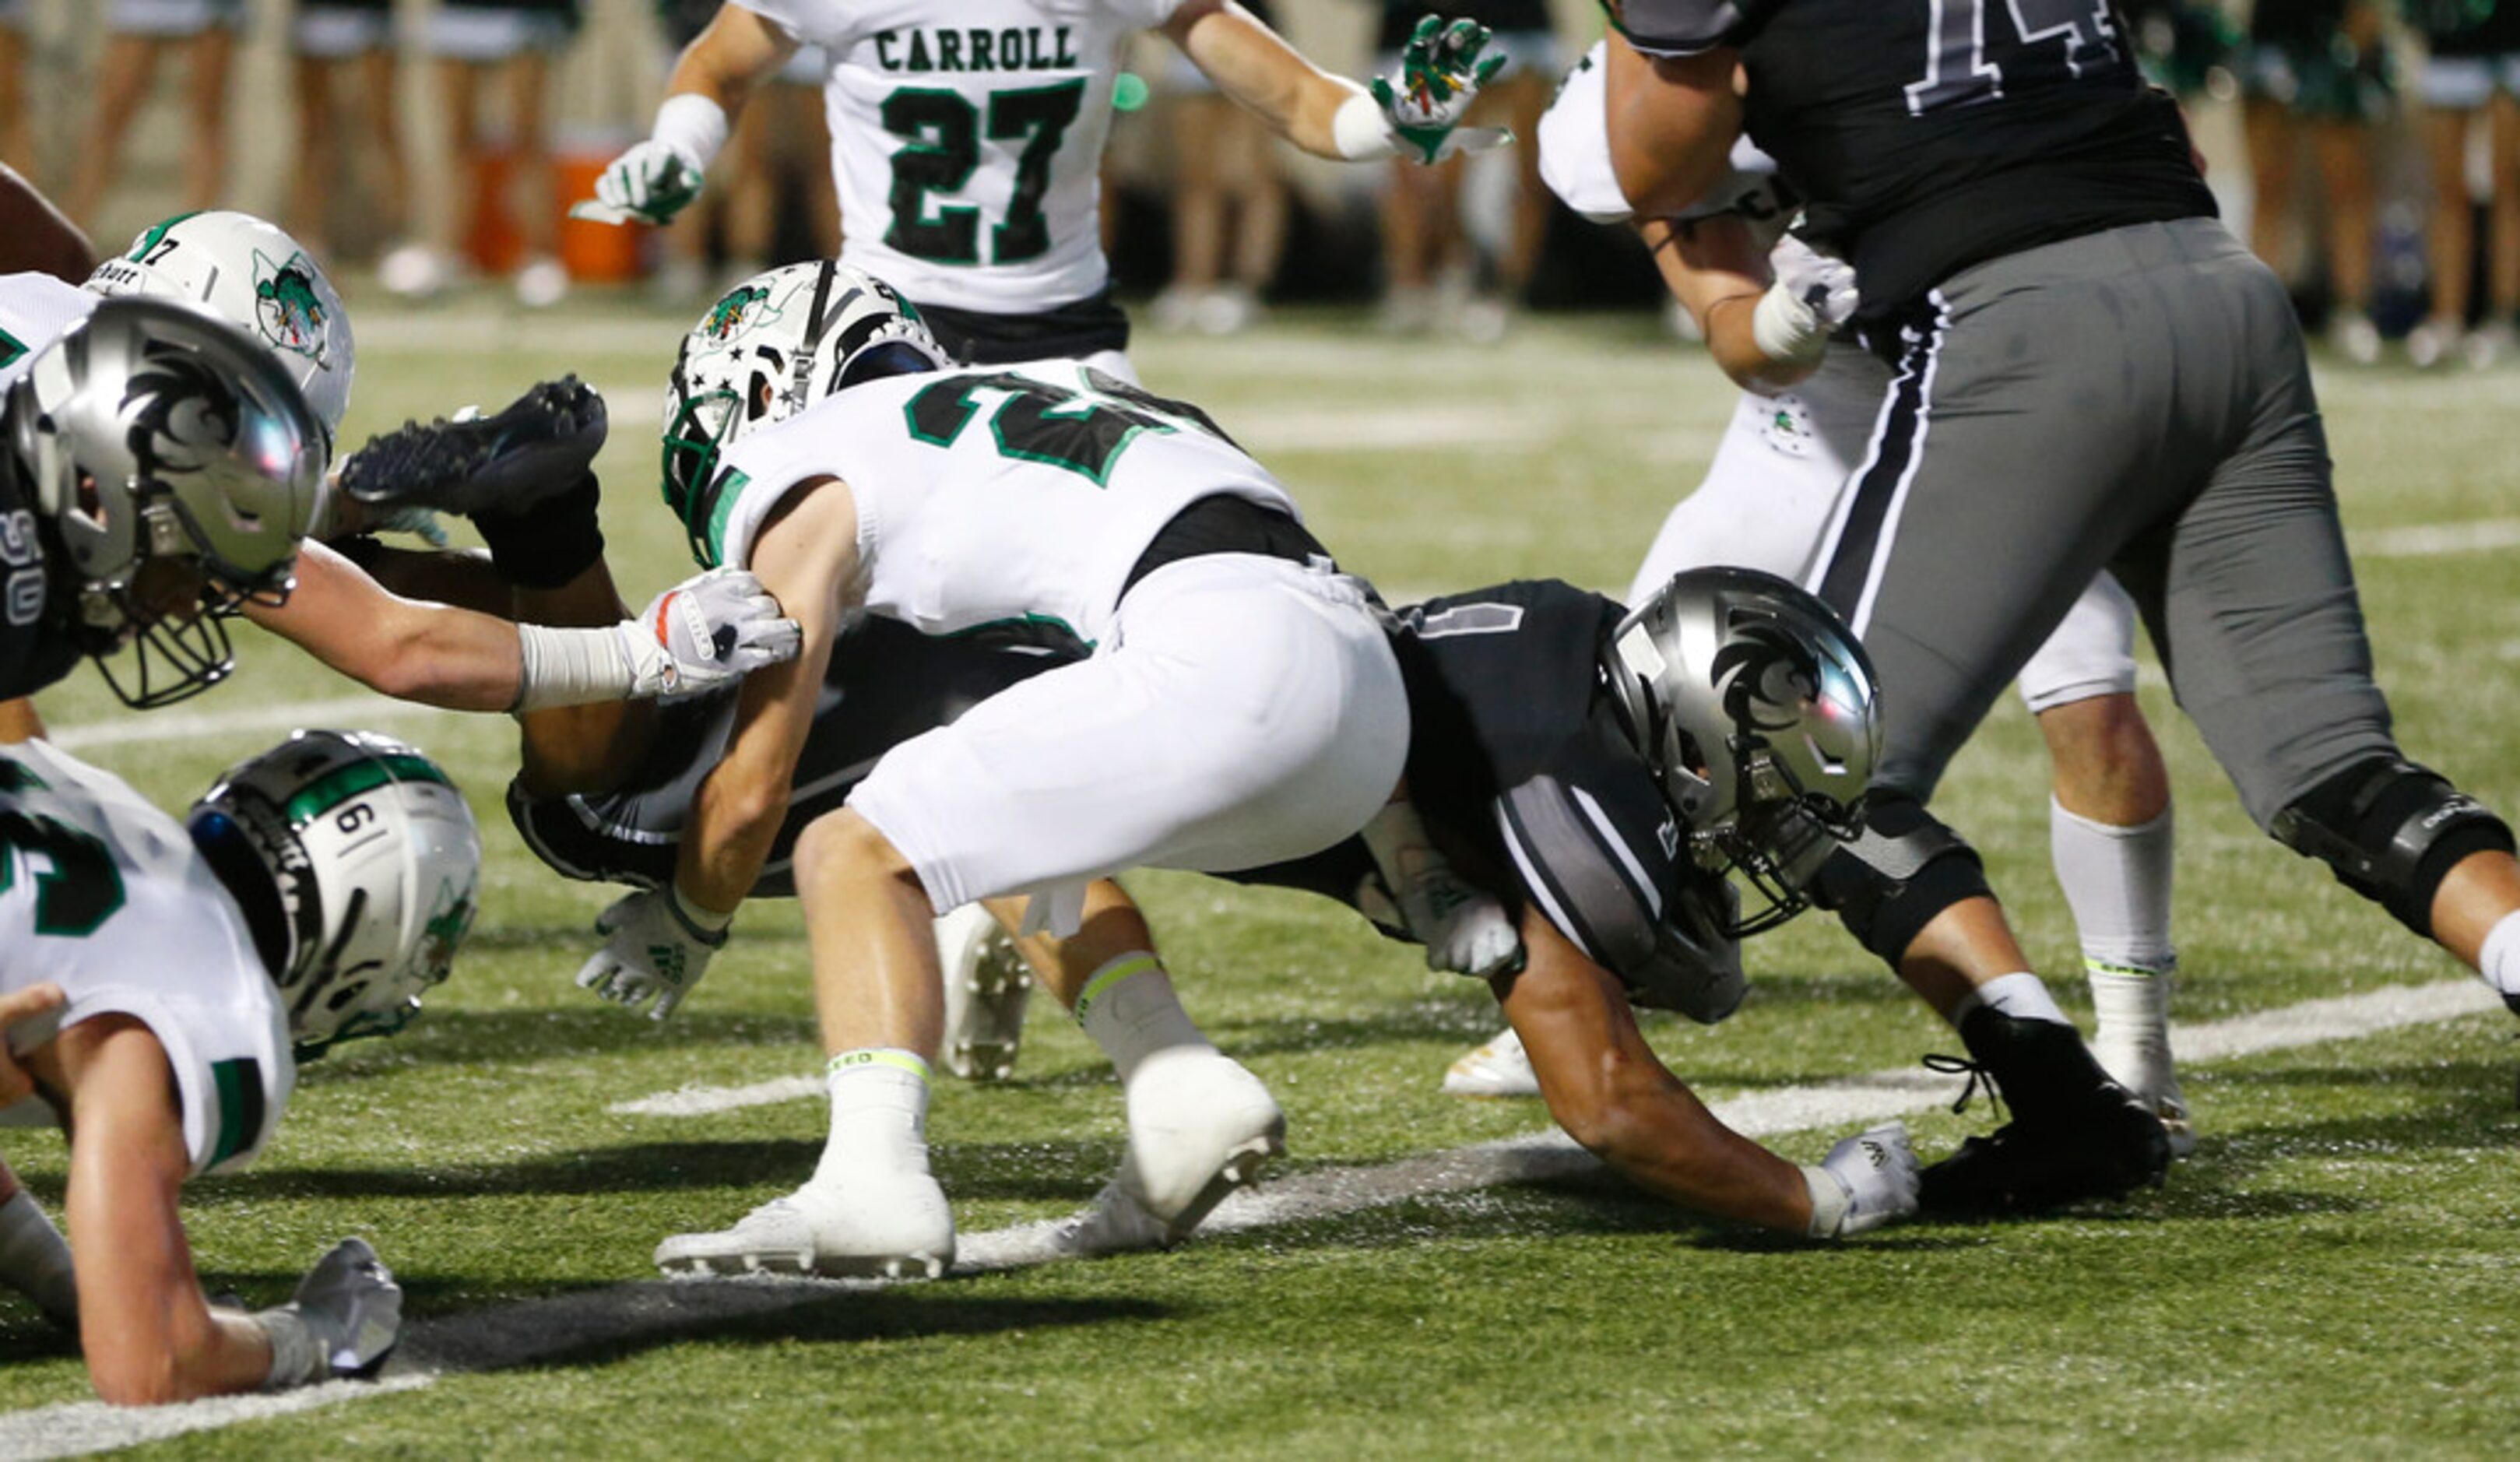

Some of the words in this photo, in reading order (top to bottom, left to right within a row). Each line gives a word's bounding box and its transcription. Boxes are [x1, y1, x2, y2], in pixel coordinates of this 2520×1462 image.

[876, 26, 1077, 71] CARROLL
[879, 77, 1088, 266] 27
[145, 238, 180, 266] 7
